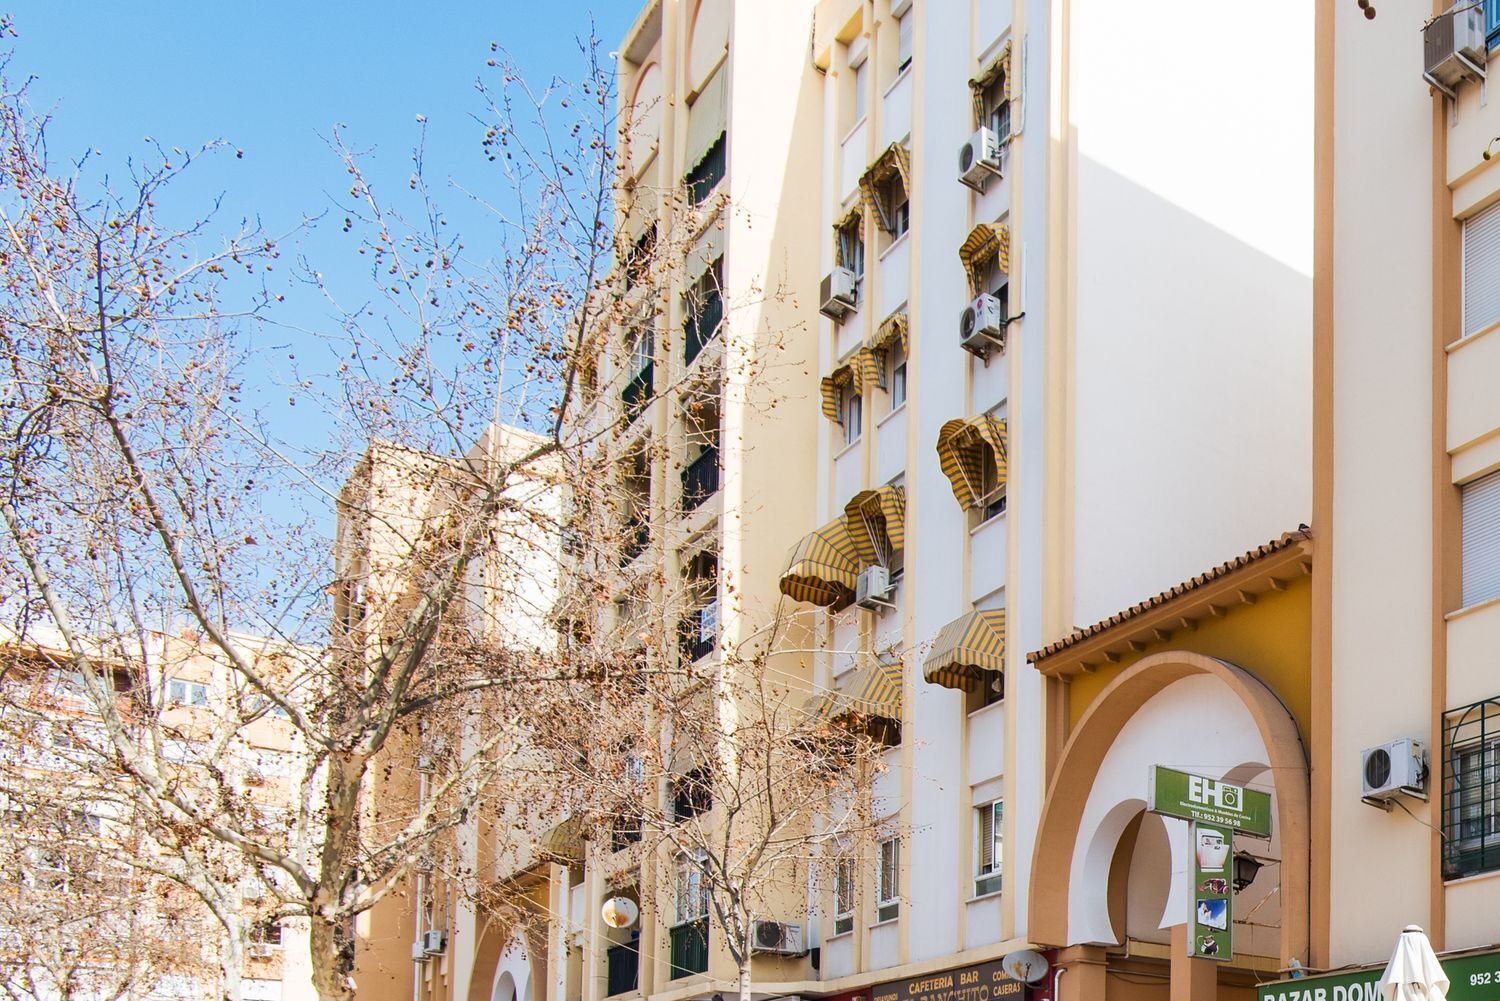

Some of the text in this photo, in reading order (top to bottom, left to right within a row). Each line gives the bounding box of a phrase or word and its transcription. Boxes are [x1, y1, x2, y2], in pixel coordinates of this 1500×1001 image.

[908, 970, 979, 994] CAFETERIA BAR
[992, 970, 1011, 982] COM
[1470, 972, 1491, 986] 952
[992, 982, 1020, 996] CASERAS
